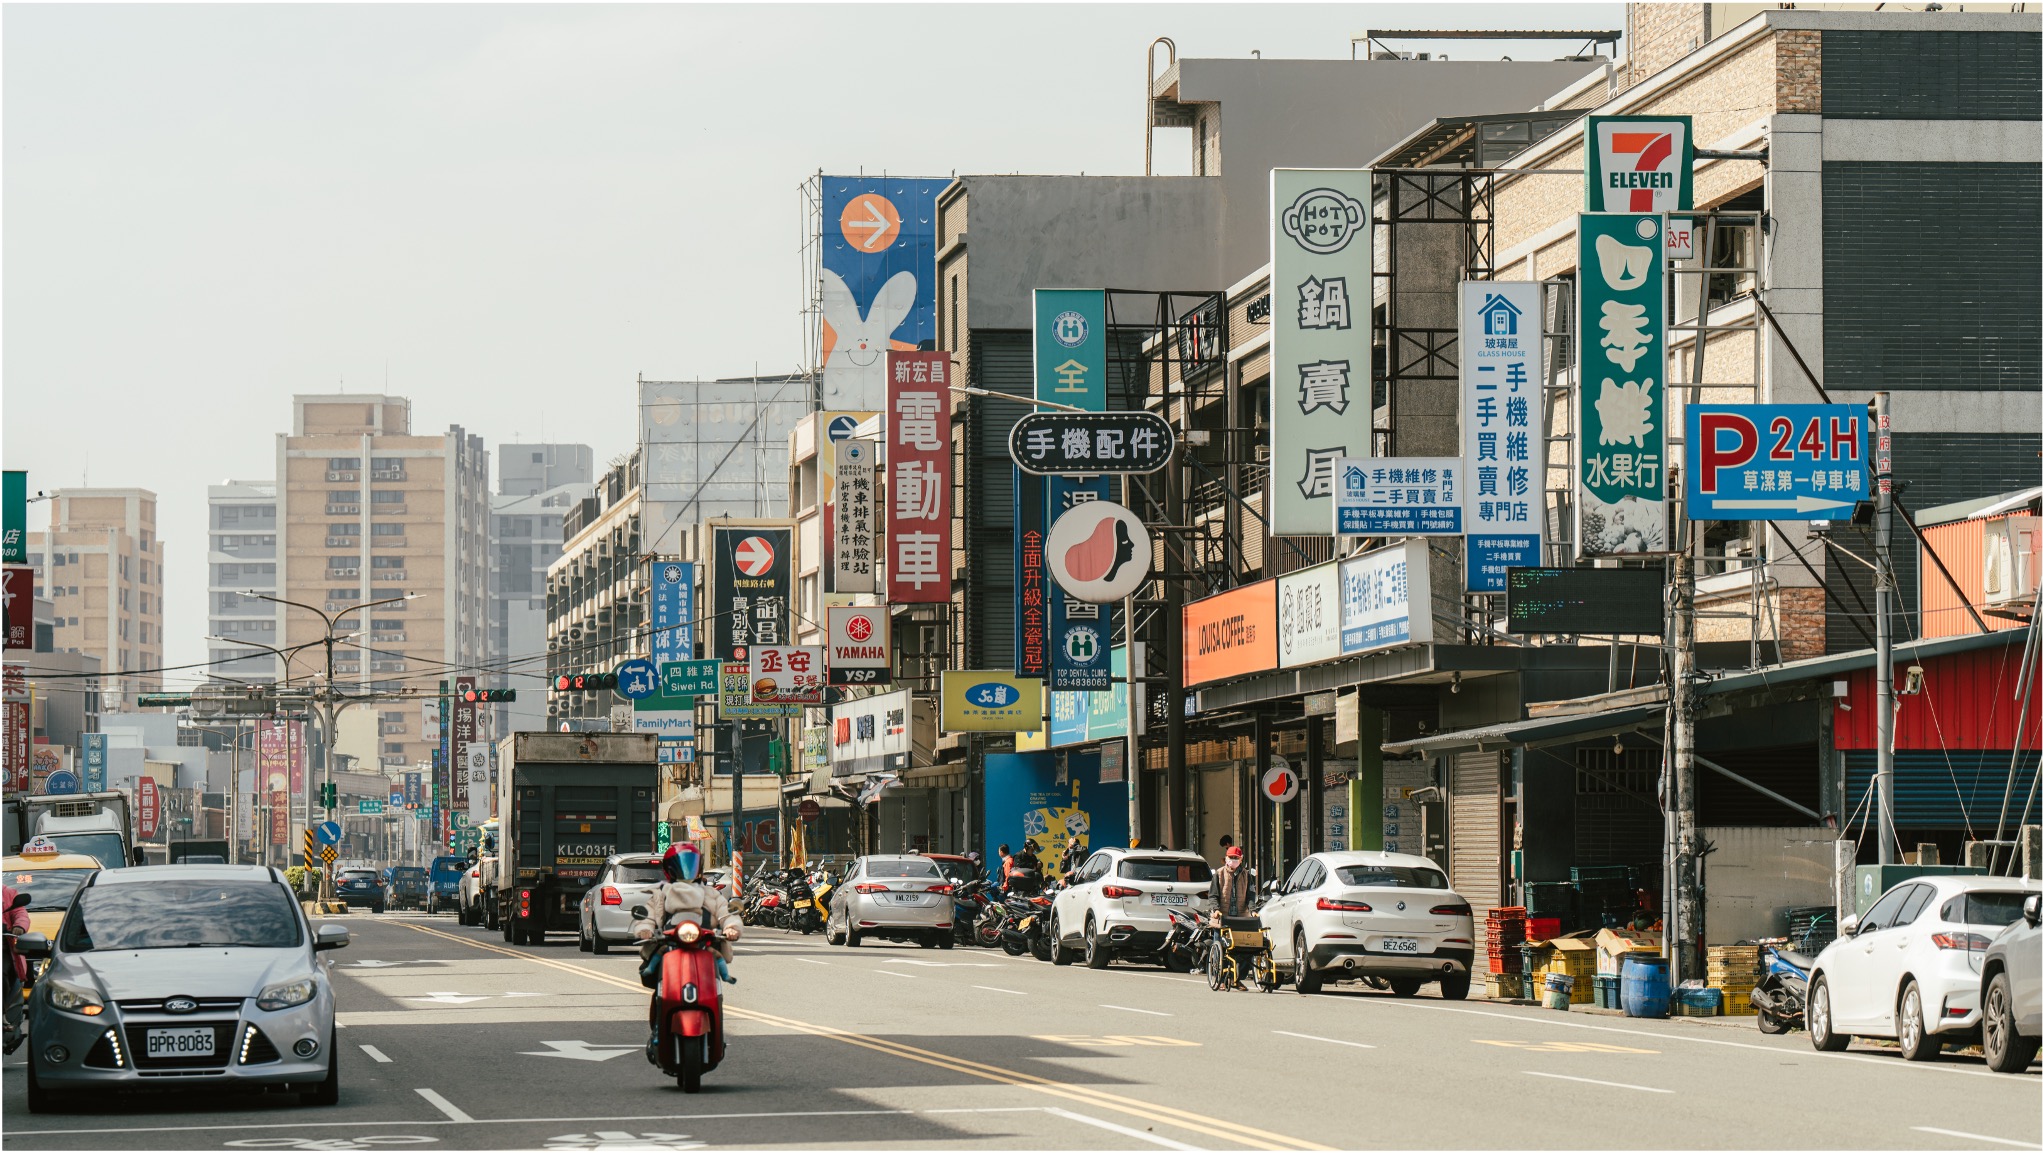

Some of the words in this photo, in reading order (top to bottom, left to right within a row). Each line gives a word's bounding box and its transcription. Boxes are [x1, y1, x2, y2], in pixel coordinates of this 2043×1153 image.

[1485, 338, 1518, 349] 玻璃屋
[894, 361, 944, 384] 新宏昌
[1053, 359, 1088, 393] 全
[1476, 366, 1498, 496] 二手買賣
[1506, 362, 1529, 497] 手機維修
[1027, 428, 1159, 460] 手機配件
[1700, 413, 1759, 494] P
[1769, 416, 1859, 461] 24H
[1878, 414, 1892, 495] 政府立案
[1371, 468, 1437, 485] 手機維修
[1586, 453, 1659, 488] 水果行
[895, 391, 943, 590] 電動車
[1442, 469, 1453, 502] 專門店
[1743, 470, 1860, 492] 草漯第一停車場
[1372, 489, 1437, 505] 二手買賣
[1478, 501, 1528, 522] 專門店
[852, 477, 870, 575] 機車排氣檢驗站
[734, 579, 775, 588] 四維路右轉
[1199, 620, 1221, 656] LOUISA
[1222, 614, 1245, 647] COFFEE
[761, 650, 811, 673] 丞安
[836, 646, 885, 659] YAMAHA
[670, 665, 713, 677] 四維路
[845, 670, 876, 682] YSP
[1057, 669, 1067, 677] TOP
[1070, 669, 1089, 677] DENTAL
[1091, 669, 1107, 677] CLINIC
[671, 682, 696, 691] Siwei
[701, 680, 715, 690] Rd.
[1057, 678, 1107, 687] 03-4836063
[636, 718, 692, 730] FamilyMart
[558, 845, 616, 856] KLC-0315
[1383, 941, 1417, 952] BEZ-6568
[170, 1000, 190, 1010] Ford
[149, 1034, 213, 1054] BPR-8083
